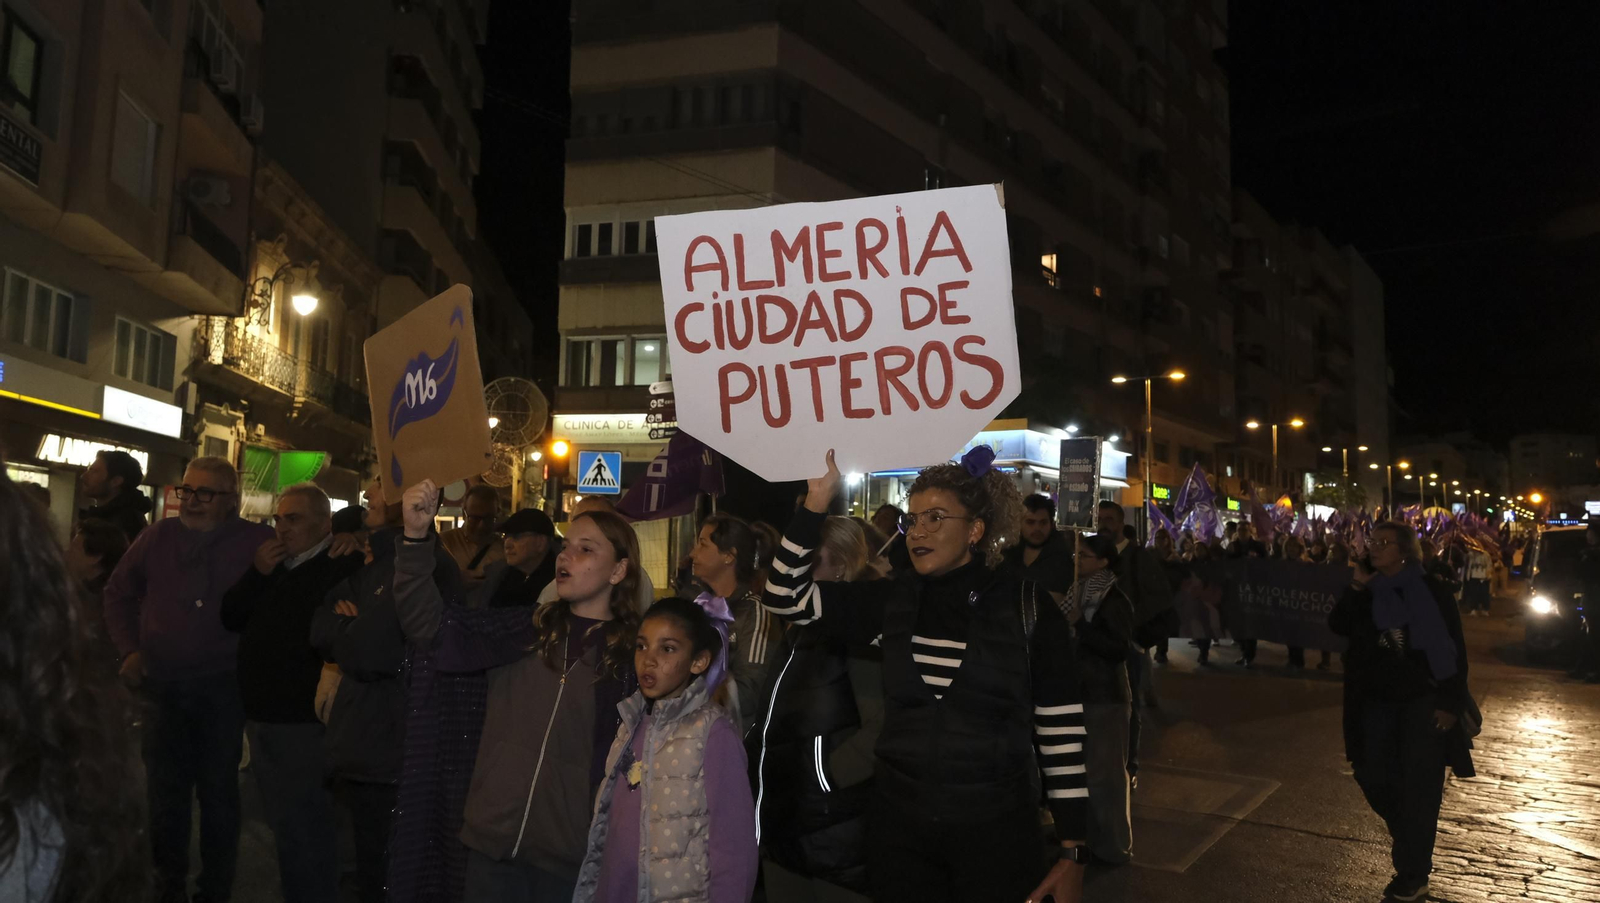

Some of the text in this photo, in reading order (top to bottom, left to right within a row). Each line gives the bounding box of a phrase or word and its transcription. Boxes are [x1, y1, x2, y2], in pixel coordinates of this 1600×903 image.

[0, 119, 38, 160] ENTAL
[899, 281, 971, 330] DE
[717, 335, 1004, 433] PUTEROS
[617, 420, 634, 430] DE
[1238, 583, 1336, 604] LA VIOLENCIA
[1238, 593, 1333, 614] TIENE MUCHO
